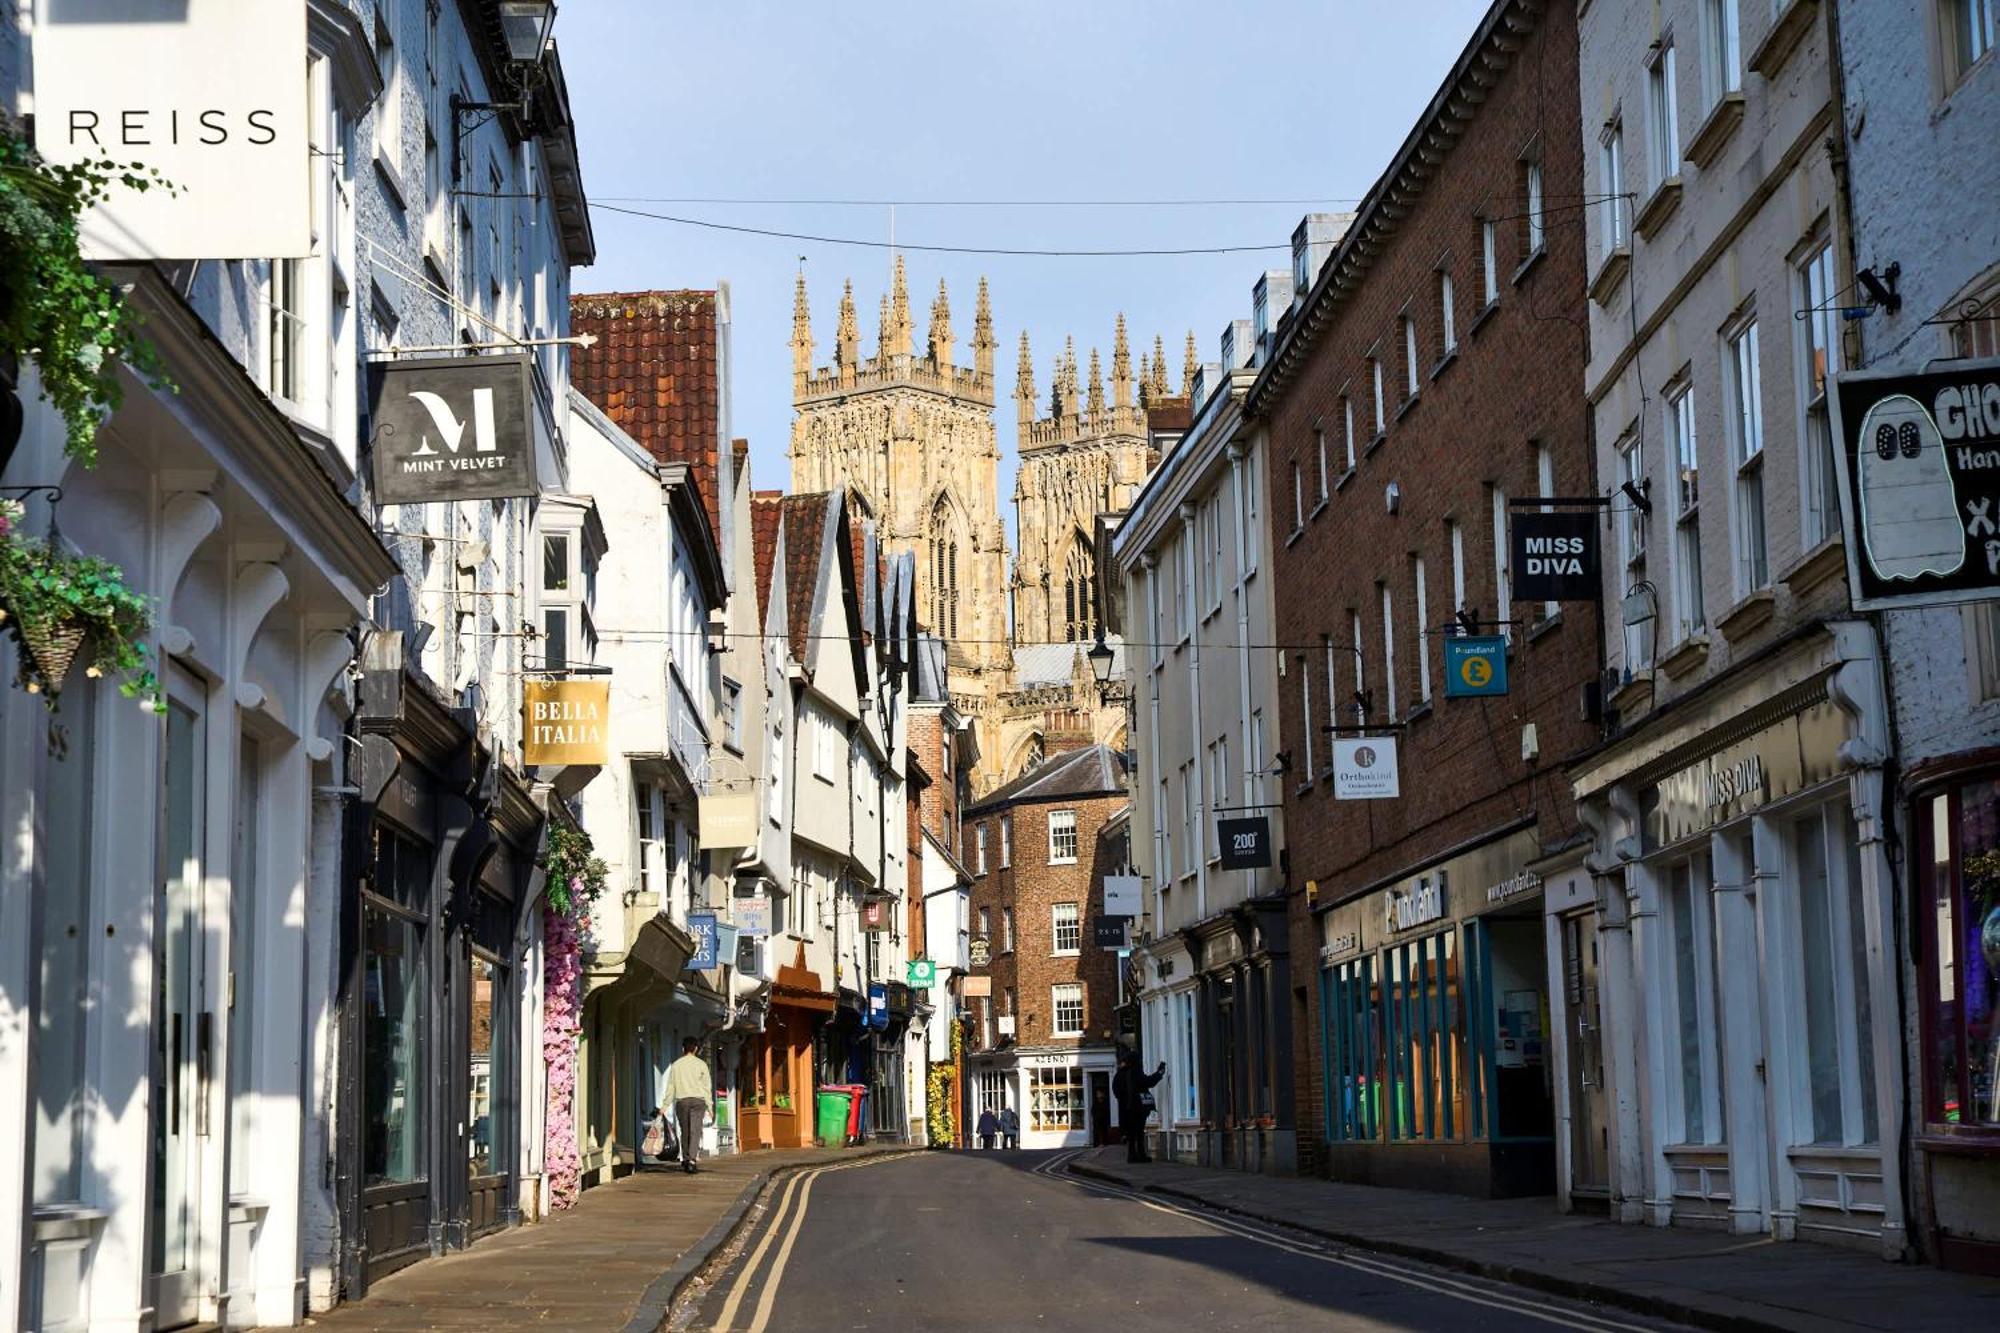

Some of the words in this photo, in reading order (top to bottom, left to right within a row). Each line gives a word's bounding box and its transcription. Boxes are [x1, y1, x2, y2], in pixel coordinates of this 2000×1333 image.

[69, 110, 276, 145] REISS
[403, 459, 445, 473] MINT
[449, 456, 506, 471] VELVET
[1525, 537, 1584, 554] MISS
[1527, 558, 1584, 575] DIVA
[1455, 646, 1496, 654] Poundland
[534, 701, 598, 721] BELLA
[533, 724, 601, 745] ITALIA
[1707, 767, 1735, 808] MISS
[1735, 754, 1764, 797] DIVA
[910, 979, 934, 988] OXFAM
[1035, 1055, 1069, 1064] AZENDI
